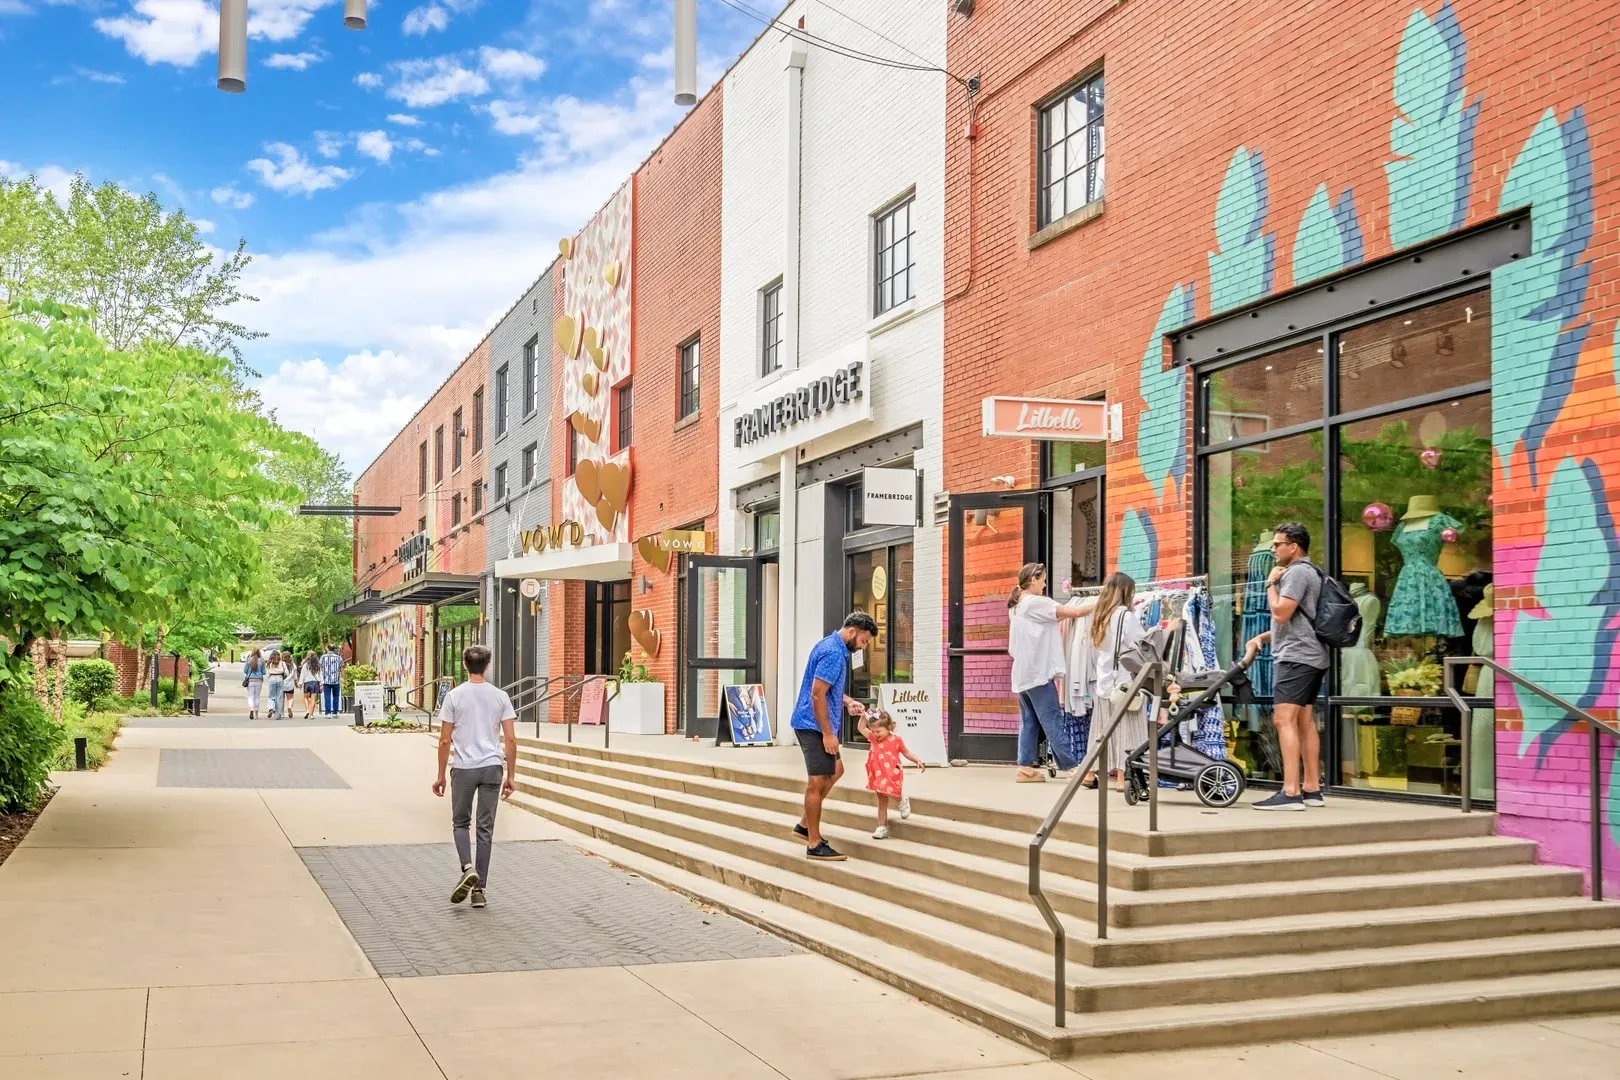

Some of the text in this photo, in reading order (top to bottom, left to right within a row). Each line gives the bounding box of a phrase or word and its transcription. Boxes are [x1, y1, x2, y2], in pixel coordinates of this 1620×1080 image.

[734, 361, 863, 448] FRAMEBRIDGE
[1016, 403, 1083, 431] Lilbelle
[866, 492, 913, 501] FRAMEBRIDGE
[892, 689, 931, 704] Lilbelle
